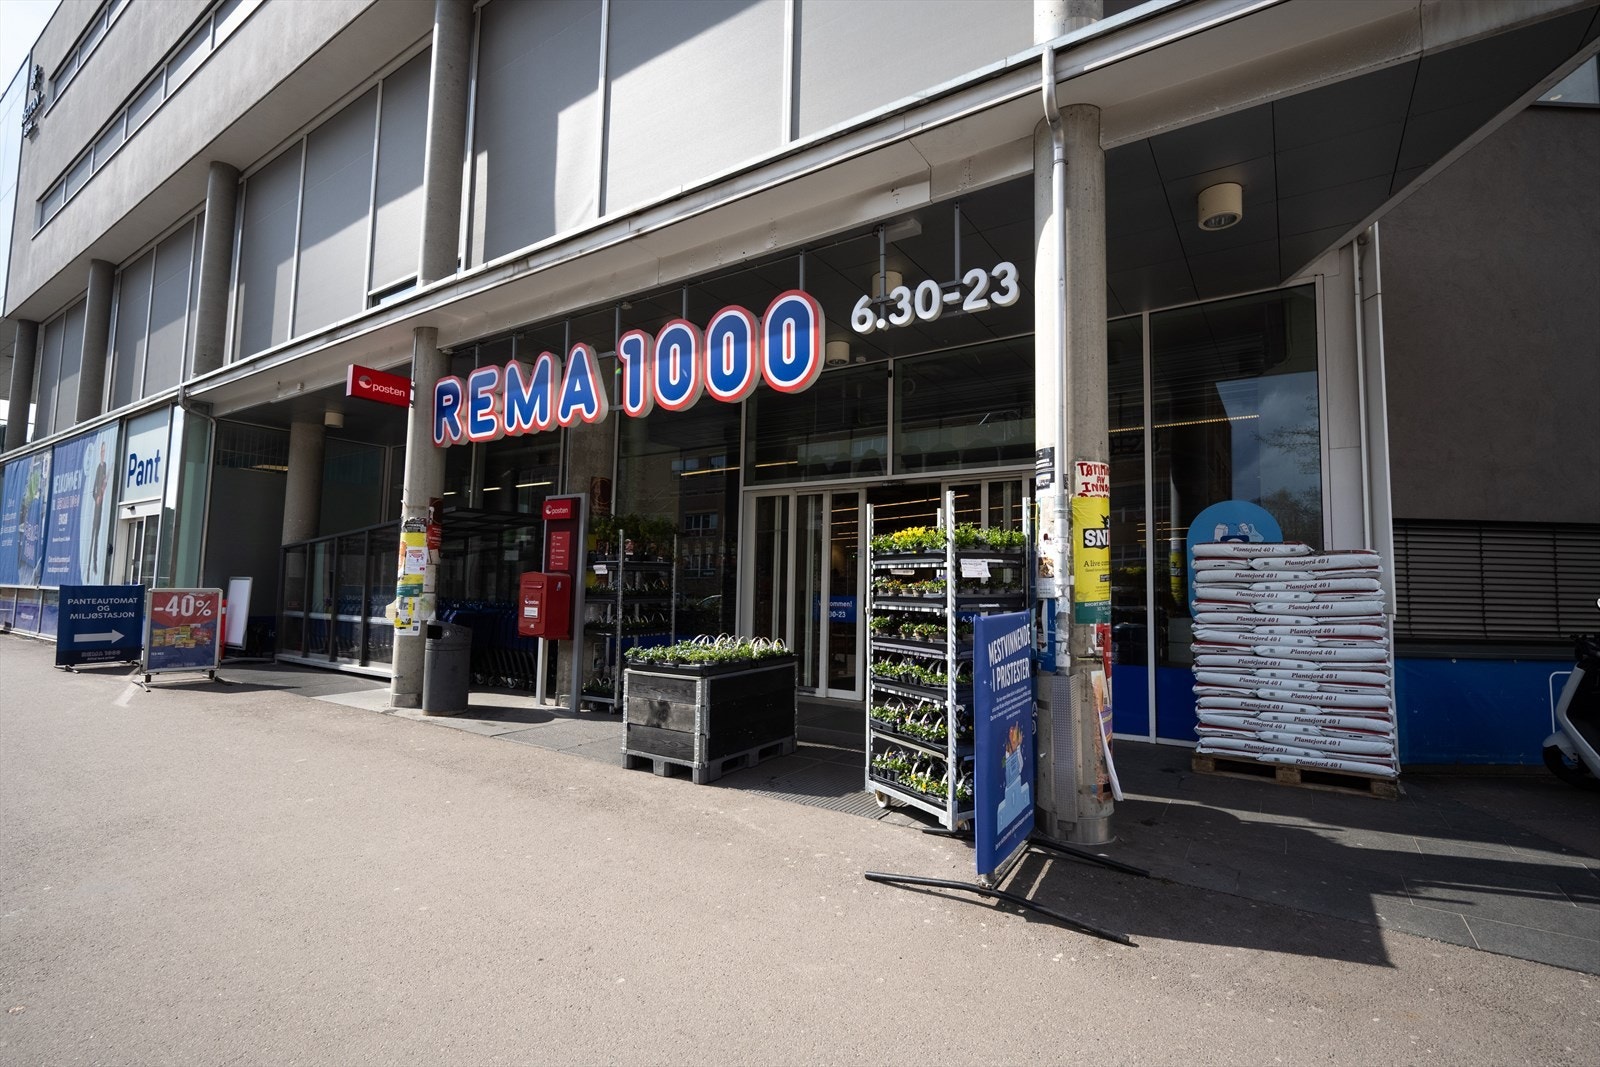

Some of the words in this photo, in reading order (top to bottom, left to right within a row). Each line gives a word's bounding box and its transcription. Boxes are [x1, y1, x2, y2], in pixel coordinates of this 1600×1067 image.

[851, 261, 1020, 335] 6.30-23
[433, 342, 608, 448] REMA
[617, 289, 826, 418] 1000
[372, 384, 405, 397] posten
[126, 449, 160, 488] Pant
[70, 612, 134, 620] MILJØSTASJON
[154, 594, 212, 616] -40%
[988, 623, 1030, 668] MESTVINNENDE
[992, 668, 996, 692] I
[996, 658, 1030, 691] PRISTESTER
